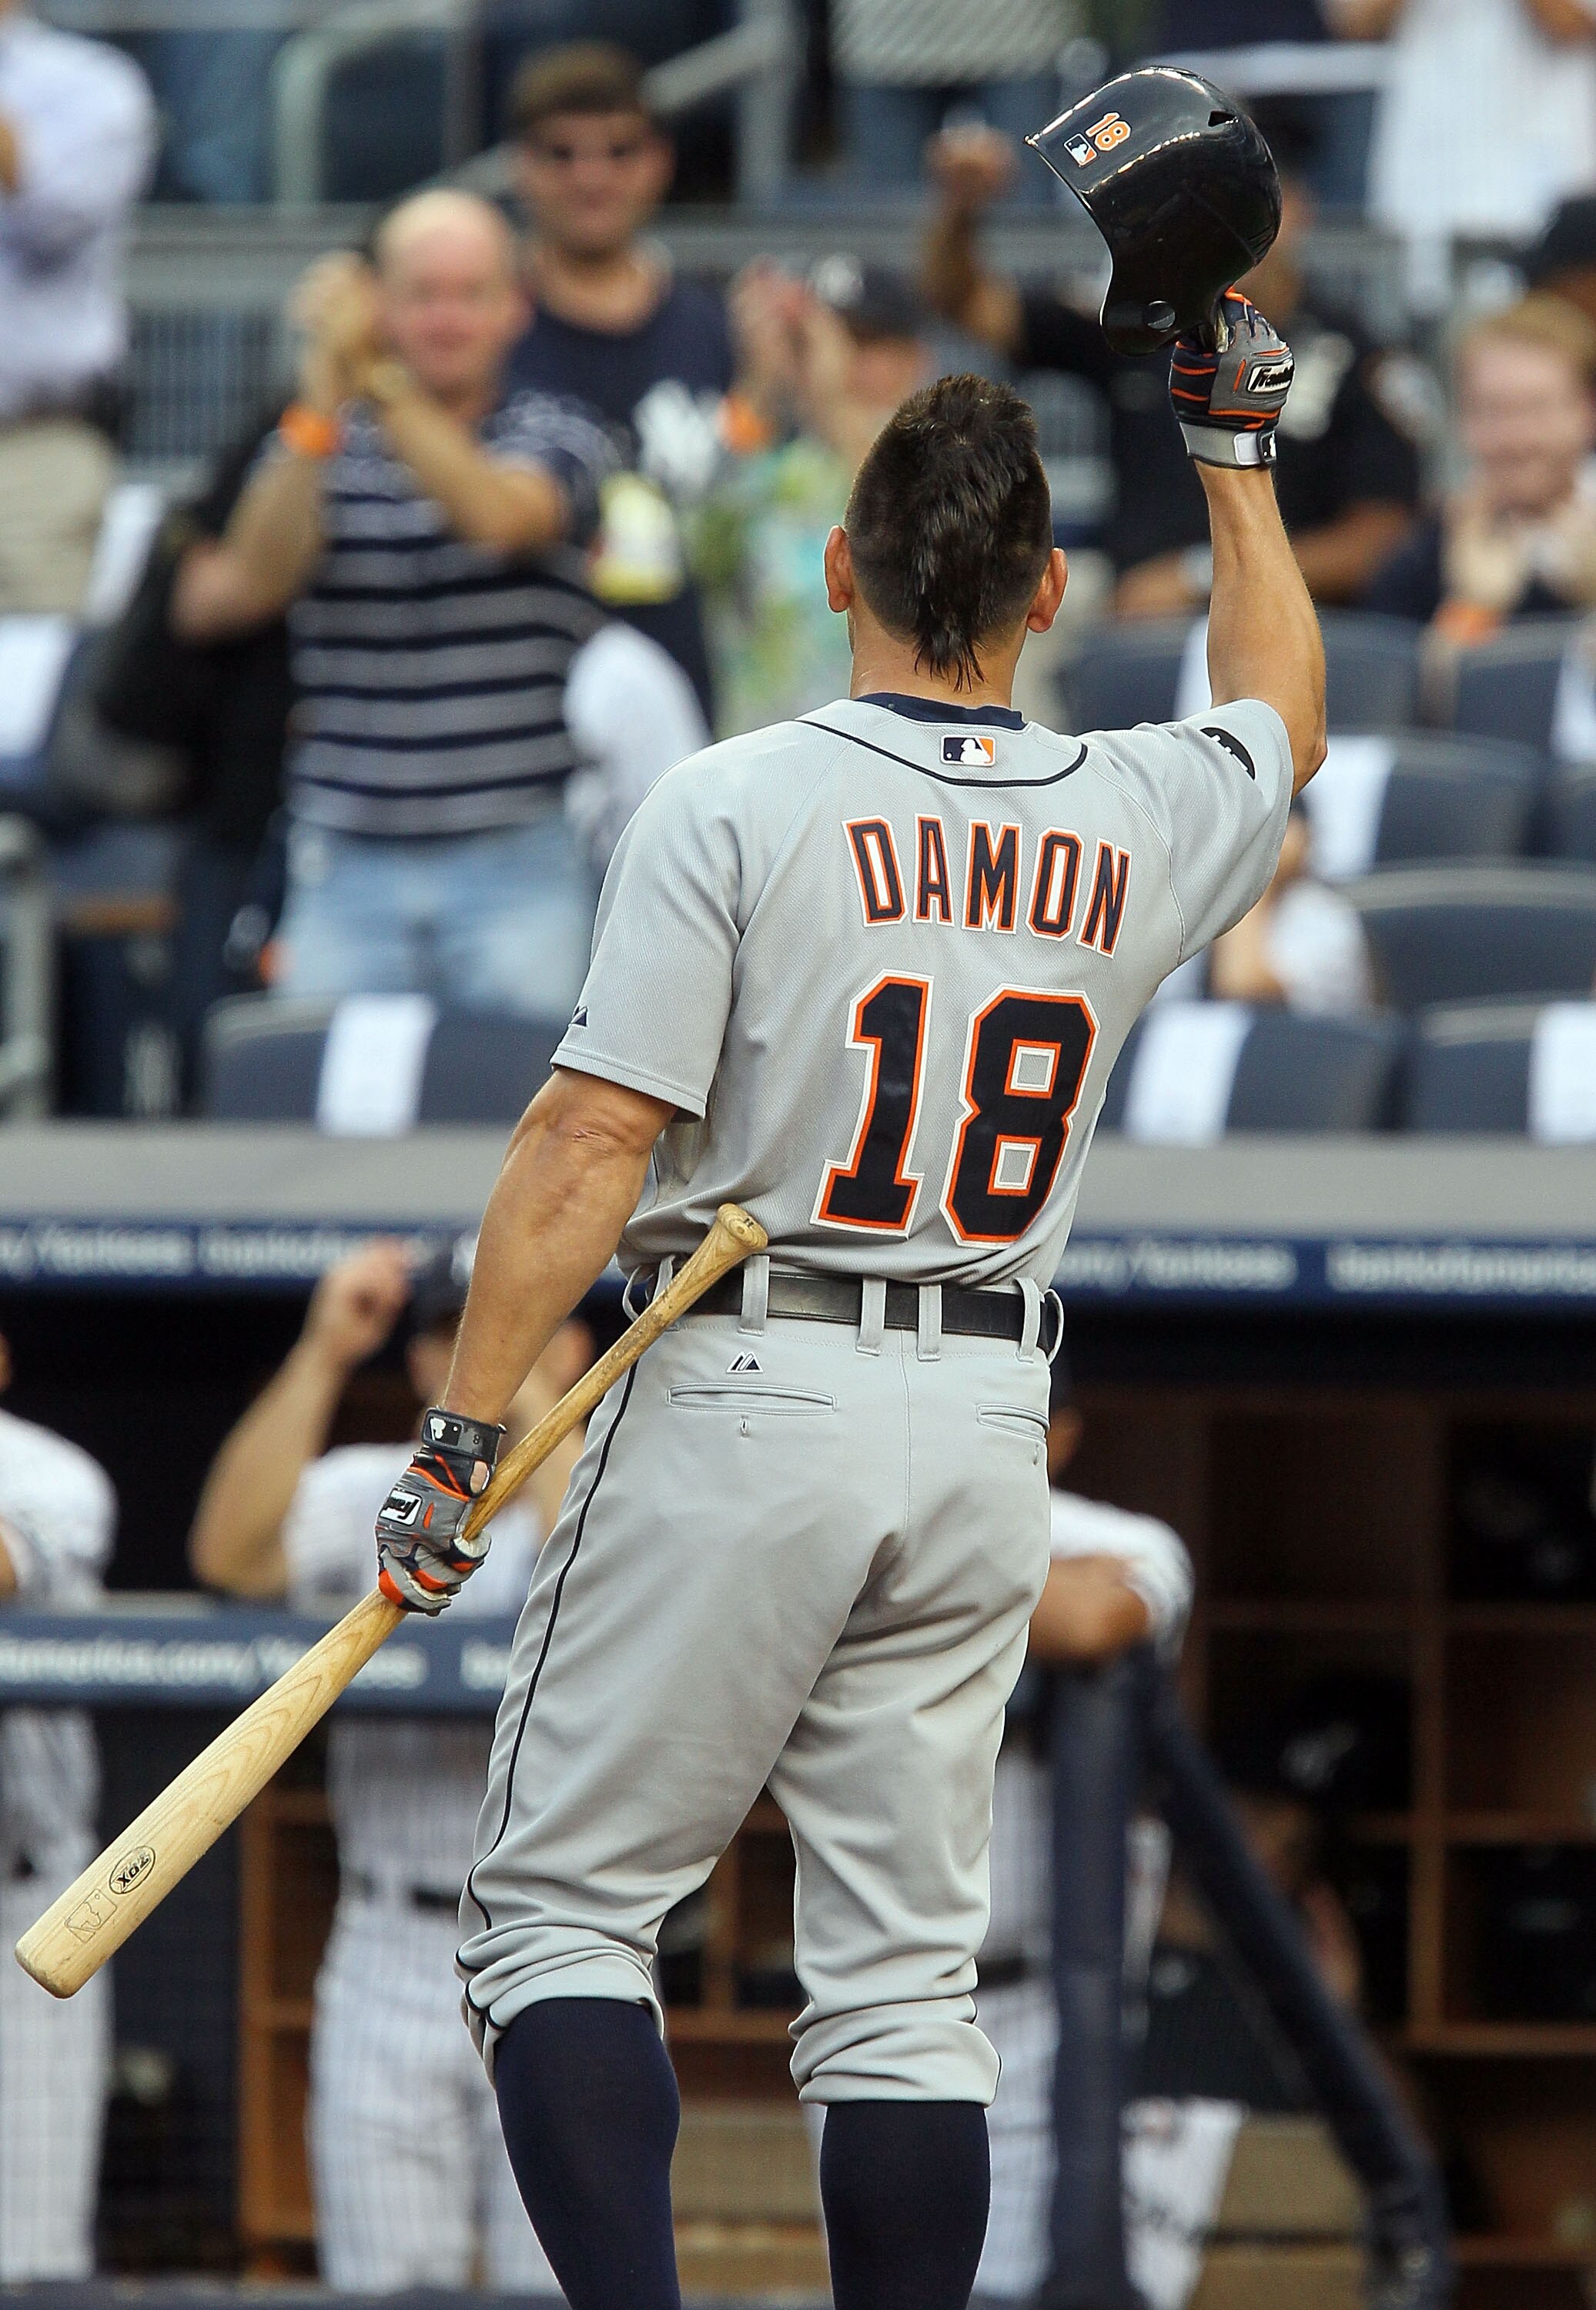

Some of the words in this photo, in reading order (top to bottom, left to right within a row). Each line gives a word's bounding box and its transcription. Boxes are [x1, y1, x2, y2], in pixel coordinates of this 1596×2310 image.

[1086, 112, 1131, 152] 18
[841, 813, 1131, 958] DAMON
[809, 969, 1101, 1249] 18
